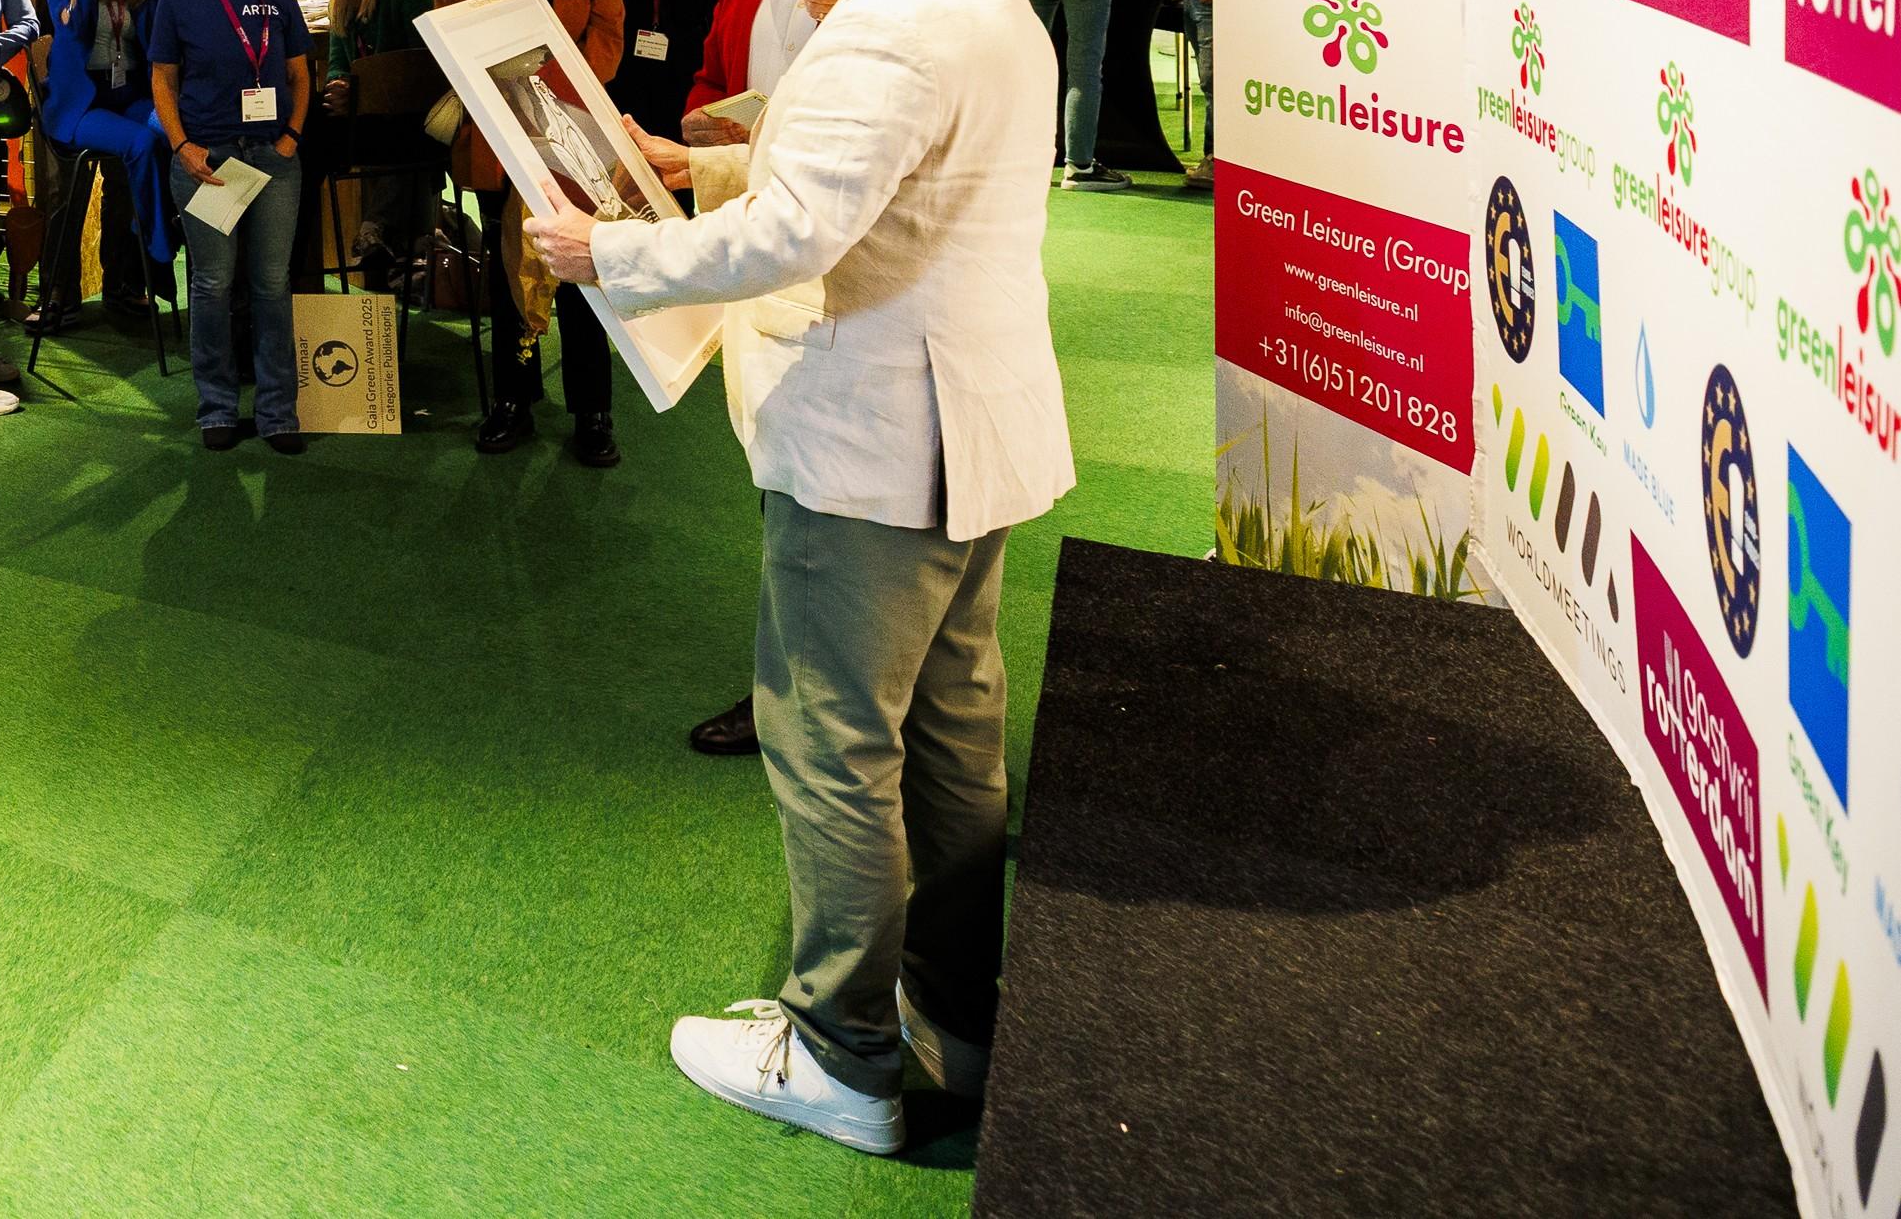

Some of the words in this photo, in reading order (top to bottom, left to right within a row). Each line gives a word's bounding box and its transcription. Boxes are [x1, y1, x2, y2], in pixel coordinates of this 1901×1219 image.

[242, 4, 280, 16] ARTIS
[1244, 78, 1466, 154] greenleisure
[1236, 189, 1296, 232] Green
[1302, 209, 1376, 259] Leisure
[1384, 235, 1470, 295] (Group
[1613, 161, 1757, 329] greenleisuregroup
[361, 297, 373, 327] 2025
[1283, 260, 1419, 323] www.greenleisure.nl
[298, 336, 309, 389] Winnaar
[362, 328, 375, 366] Award
[381, 305, 394, 368] Publieksprijs
[1284, 301, 1425, 373] info@greenleisure.nl
[365, 367, 376, 402] Green
[384, 370, 396, 422] Categorie:
[1258, 335, 1459, 443] +31(6)51201828
[1559, 391, 1587, 436] Green
[366, 404, 378, 430] Gaia
[1505, 515, 1627, 695] WORLDMEETINGS
[1683, 668, 1756, 864] gastvrij
[1645, 662, 1760, 939] rotterdam
